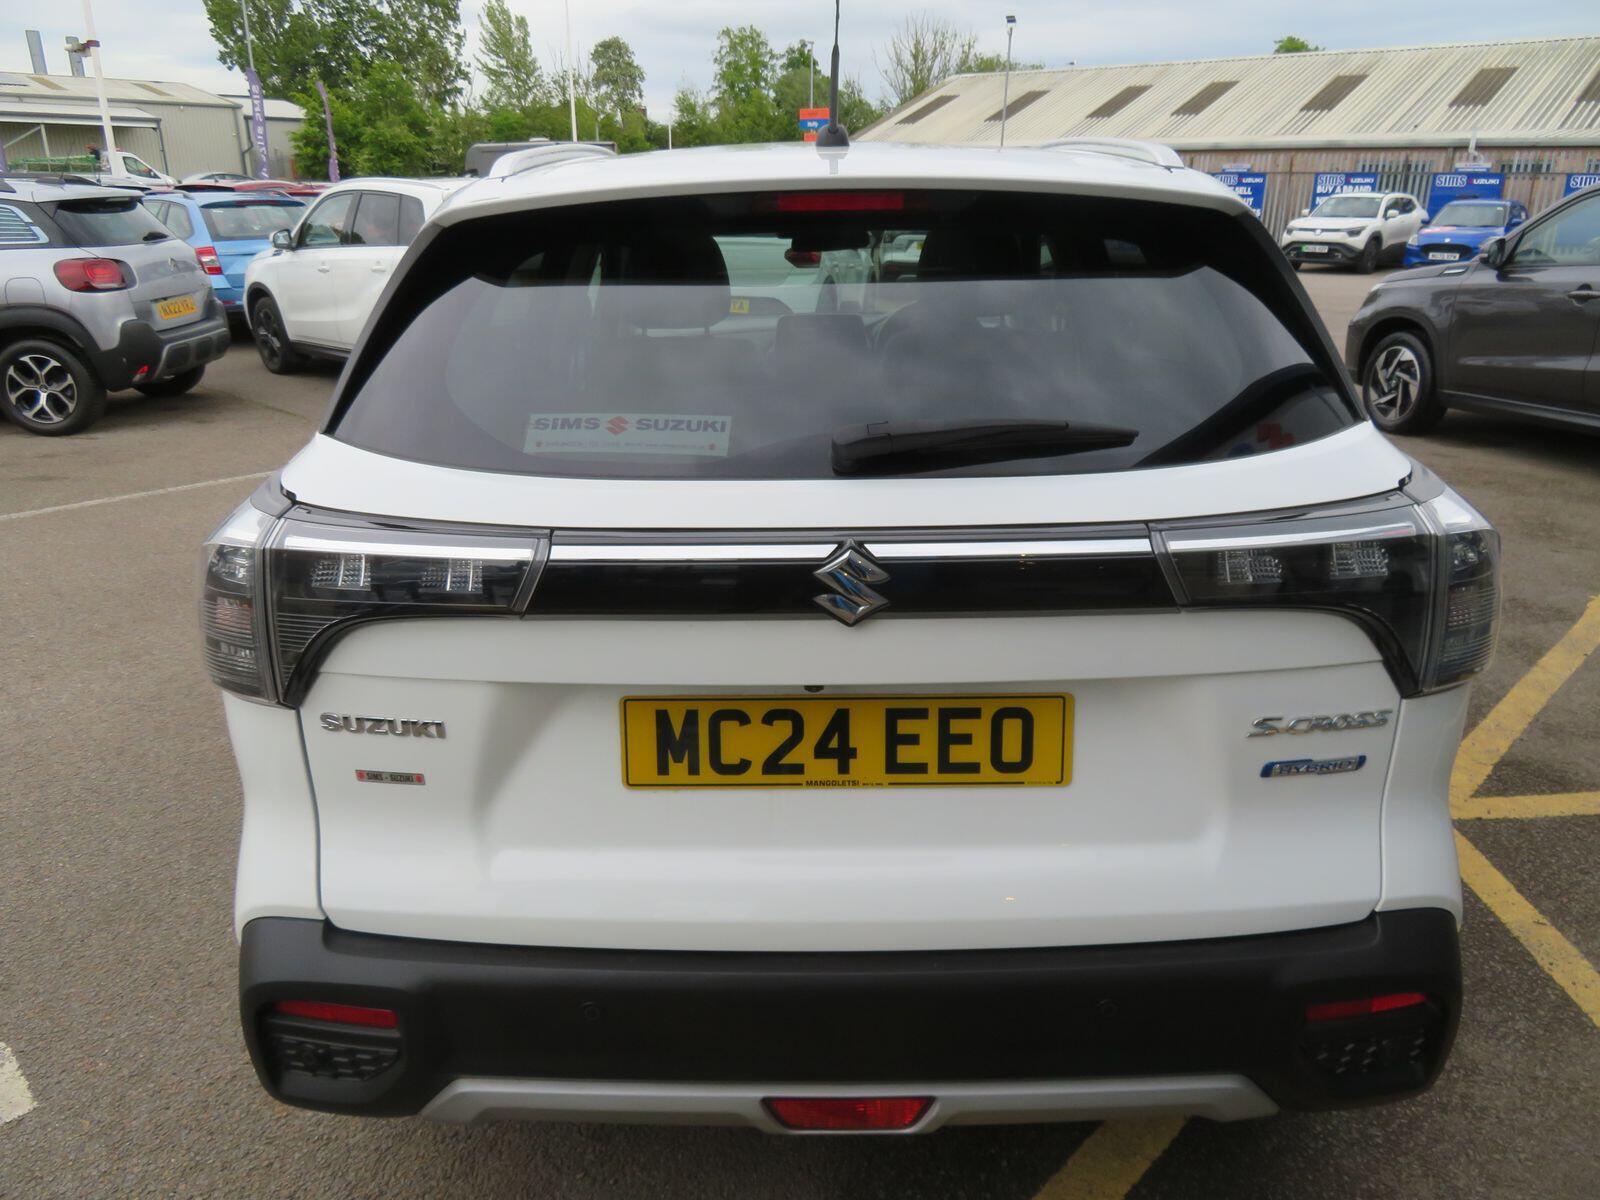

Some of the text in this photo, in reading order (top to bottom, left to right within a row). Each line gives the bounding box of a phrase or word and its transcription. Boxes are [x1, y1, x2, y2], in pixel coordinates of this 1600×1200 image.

[1436, 174, 1467, 187] SIMS
[1316, 185, 1334, 194] BUY
[533, 416, 728, 433] SIMS SUZUKI
[319, 711, 448, 740] SUZUKI
[654, 706, 1035, 777] MC24 EEO
